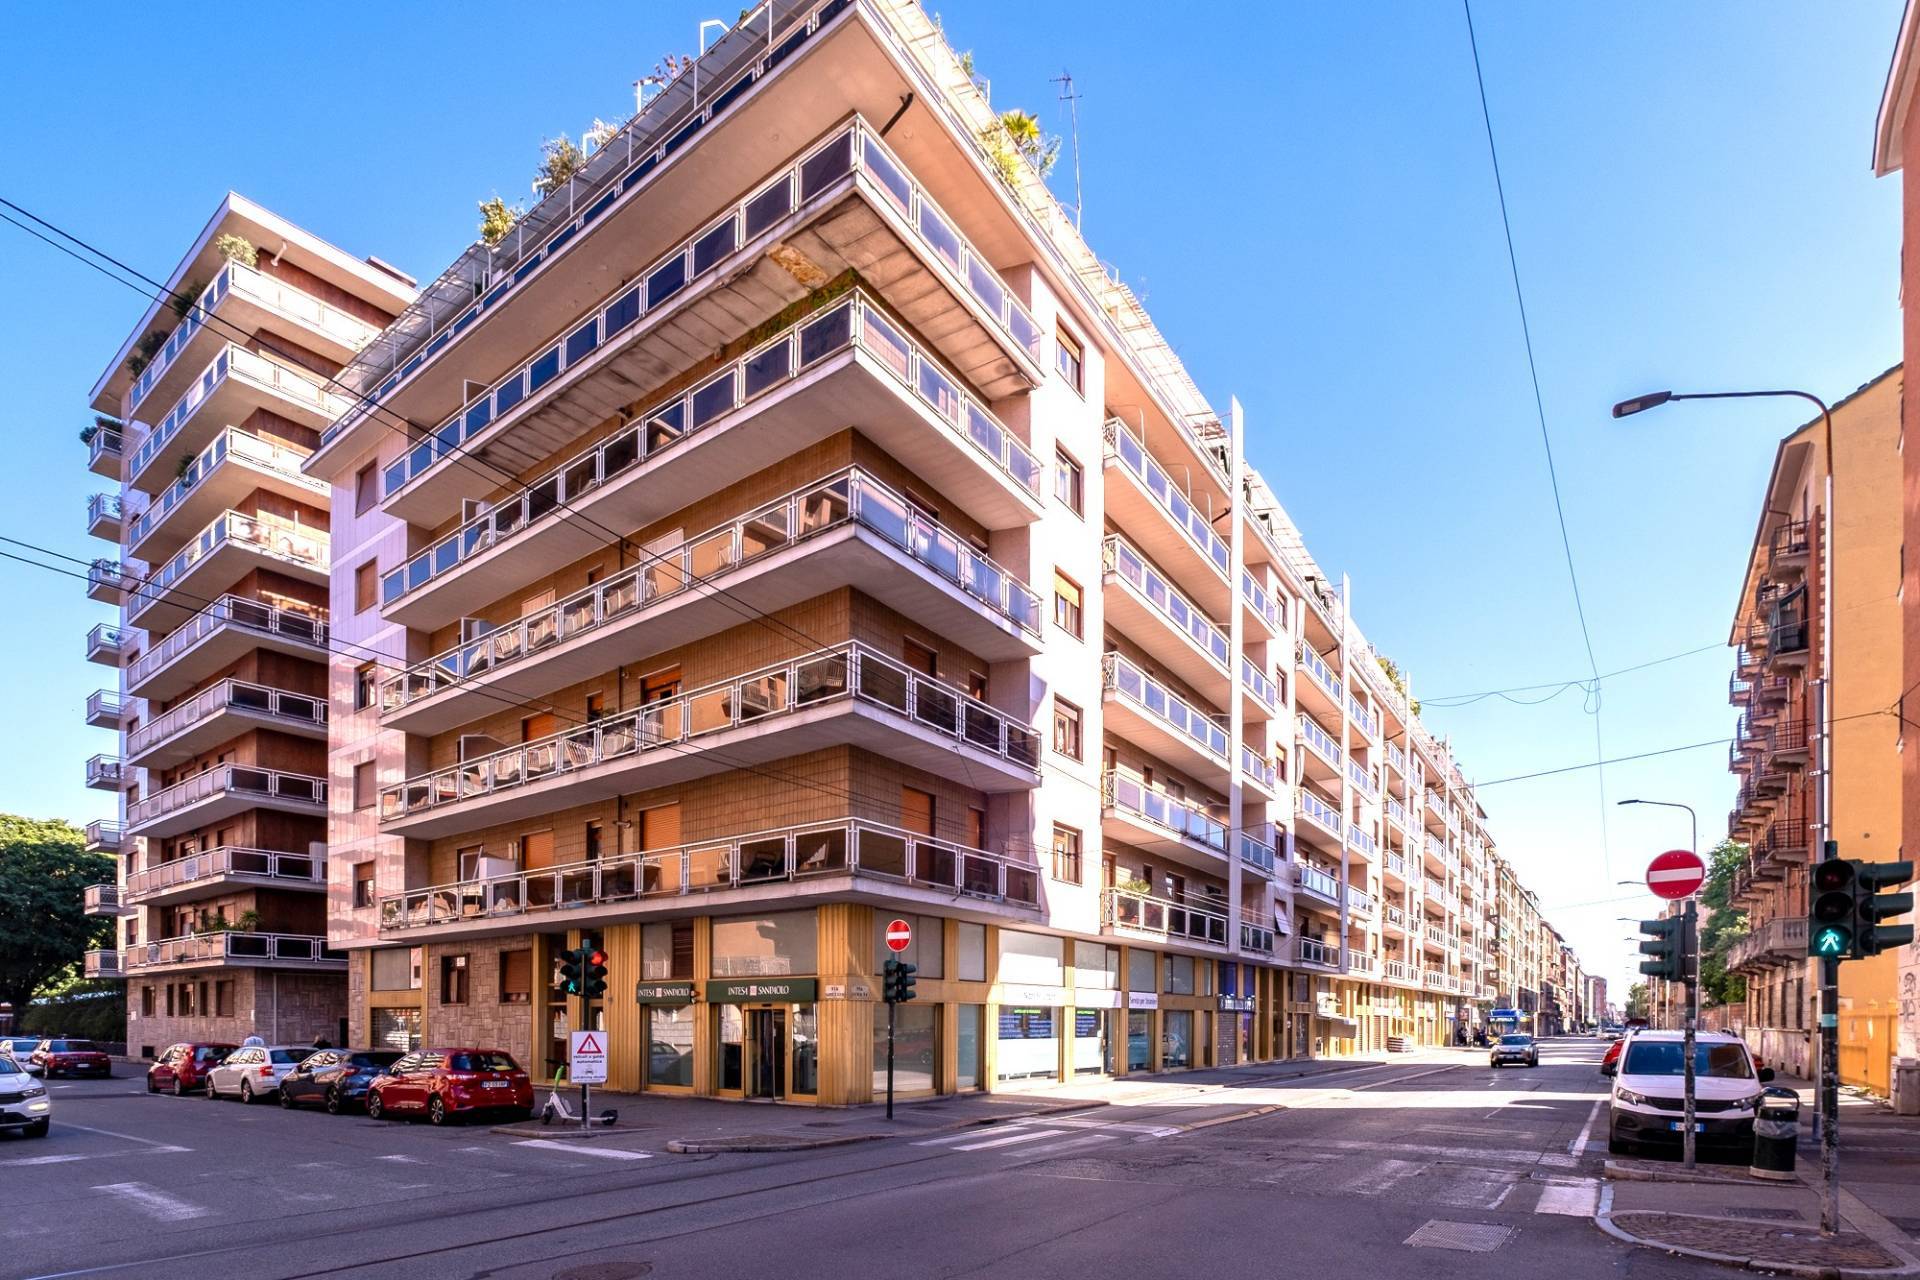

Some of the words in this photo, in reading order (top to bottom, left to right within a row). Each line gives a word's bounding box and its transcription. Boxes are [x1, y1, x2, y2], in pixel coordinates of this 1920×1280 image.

[663, 988, 690, 997] SANPAOLO
[728, 986, 748, 996] INTESA
[758, 985, 790, 995] SANPAOLO
